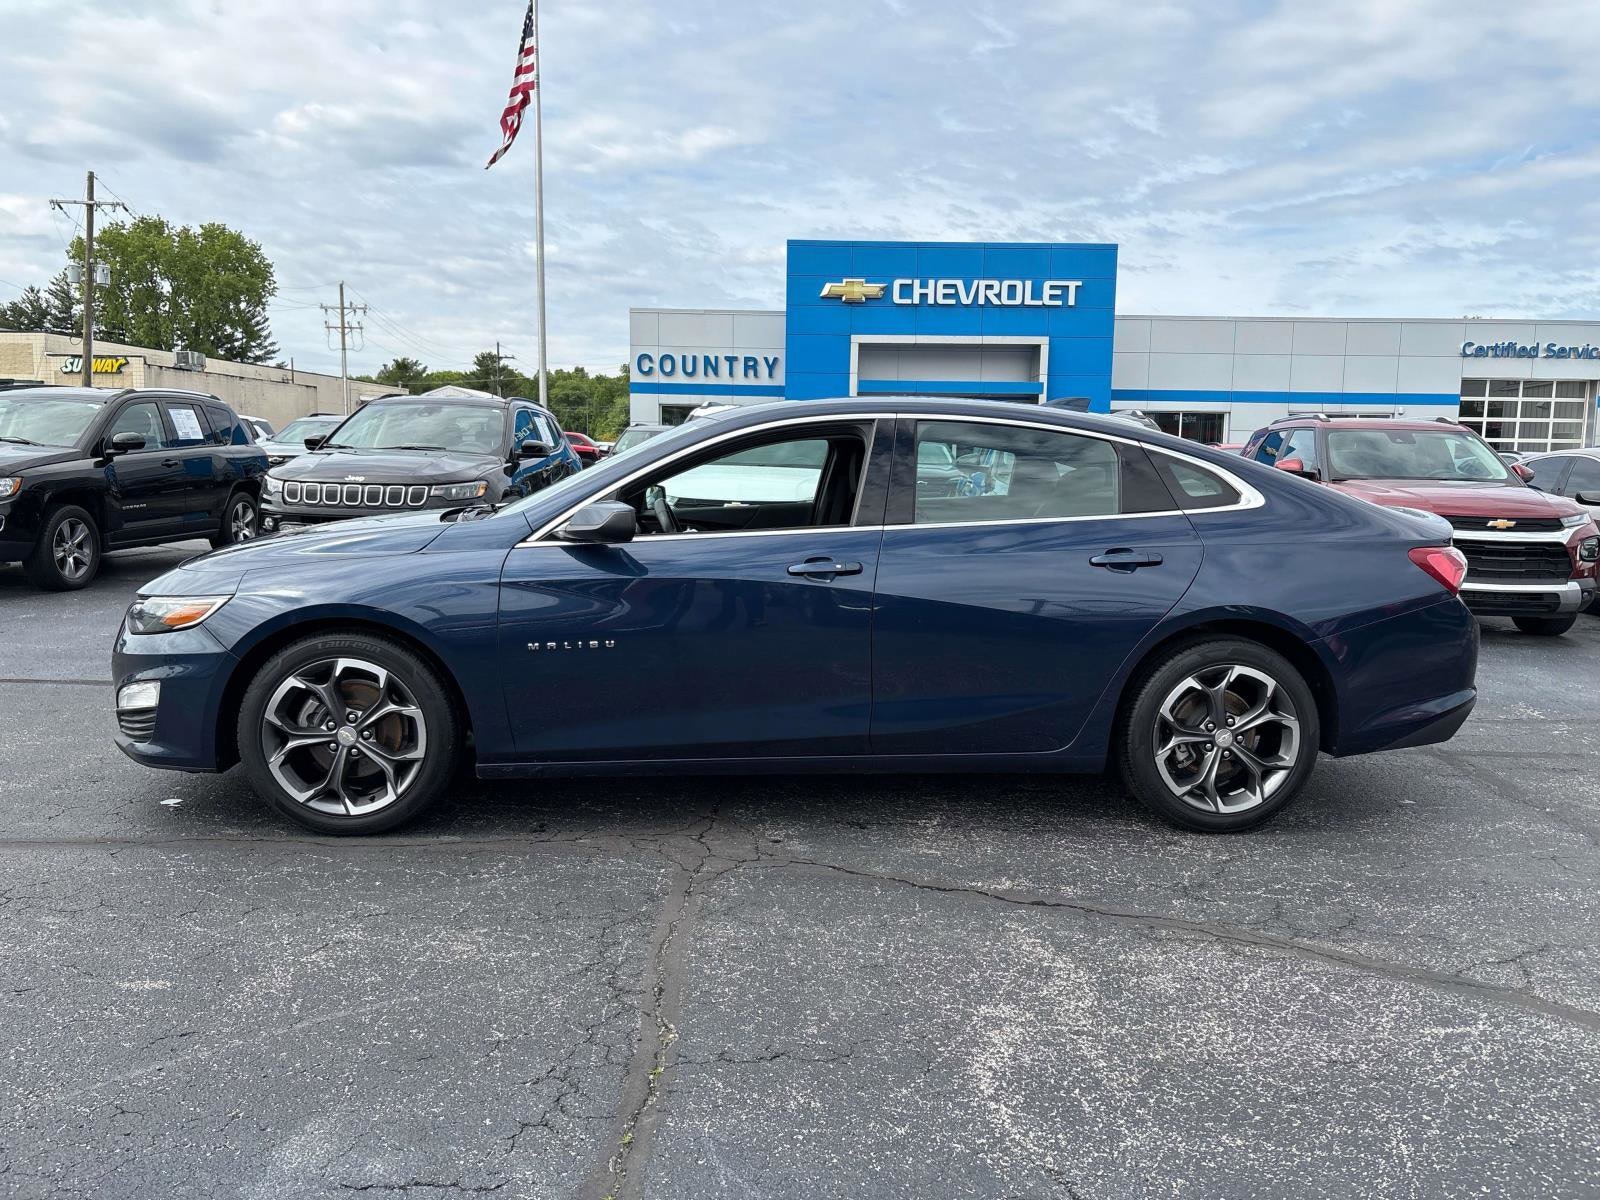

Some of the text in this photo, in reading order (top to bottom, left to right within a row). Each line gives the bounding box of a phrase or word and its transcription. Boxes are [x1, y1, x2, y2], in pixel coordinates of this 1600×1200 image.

[892, 279, 1082, 306] CHEVROLET
[1462, 341, 1600, 360] Certified Servic
[62, 357, 127, 374] SUWAY
[636, 353, 779, 379] COUNTRY
[527, 640, 615, 650] MALIBU
